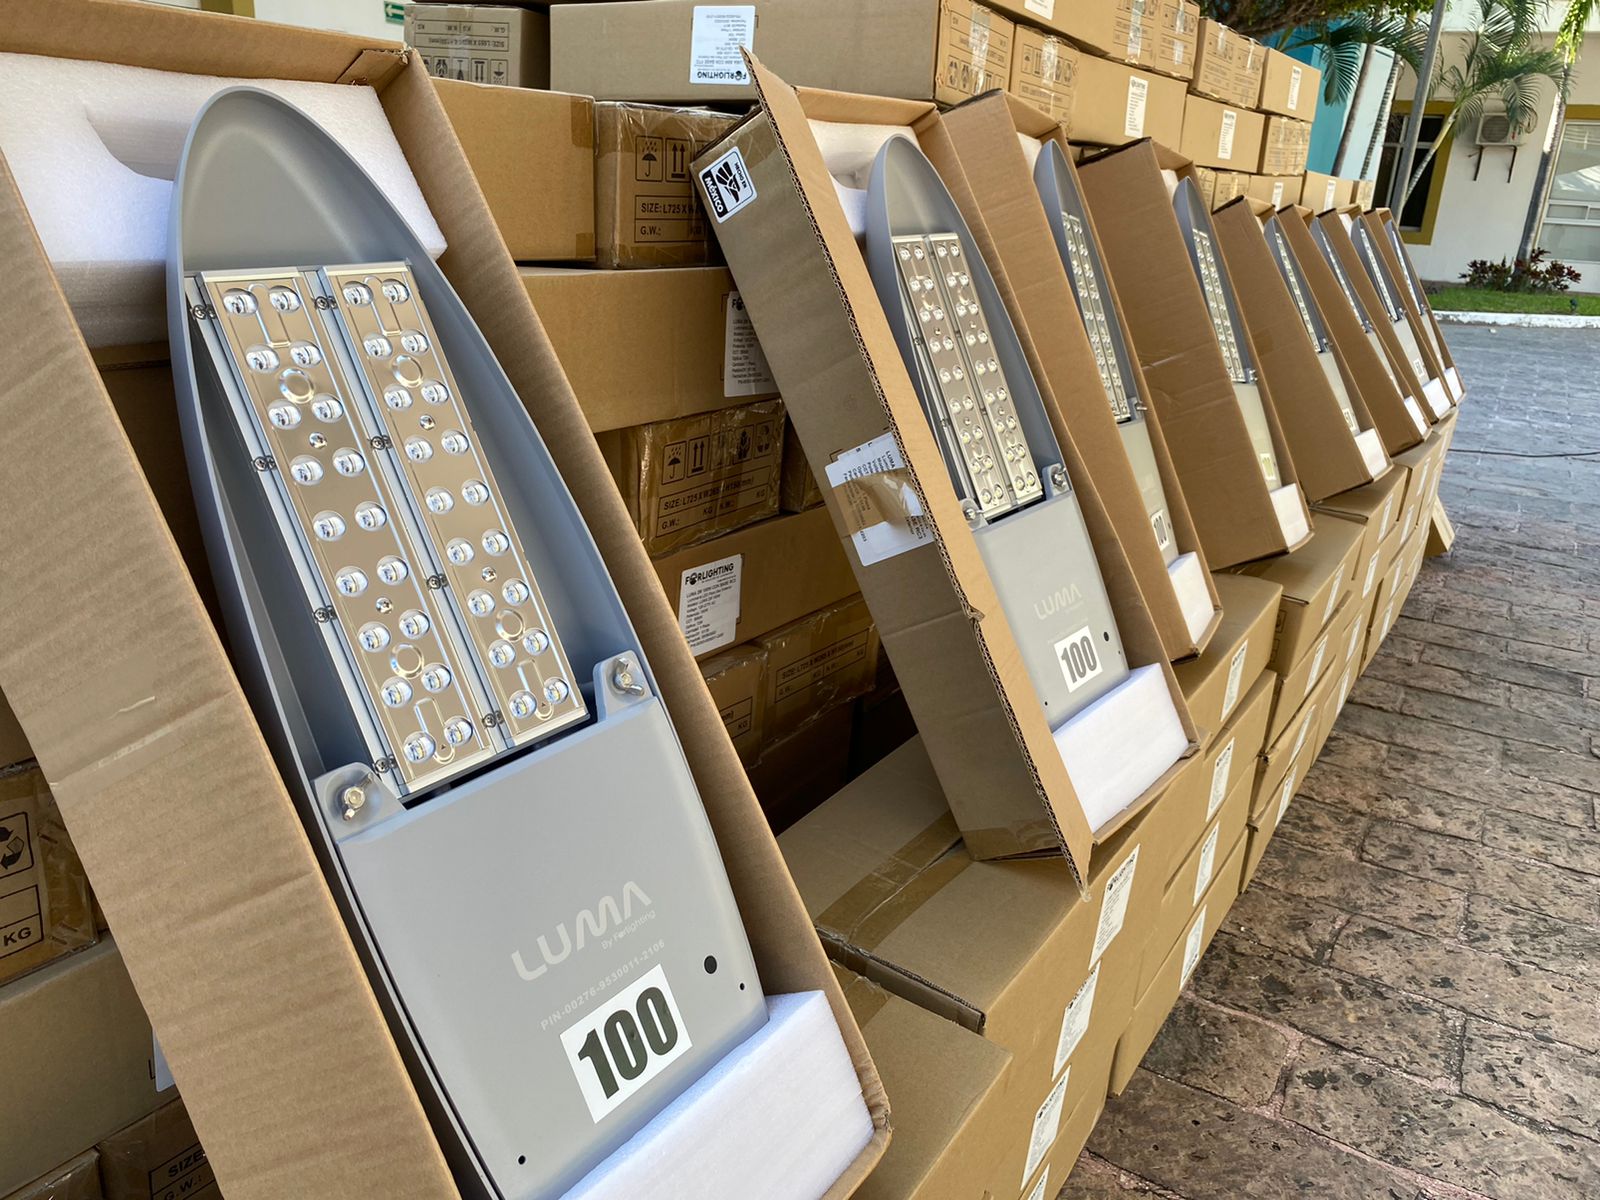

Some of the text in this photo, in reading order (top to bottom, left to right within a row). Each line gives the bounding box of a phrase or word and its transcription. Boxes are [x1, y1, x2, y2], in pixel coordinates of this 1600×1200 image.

[641, 202, 662, 213] SIZE:
[663, 205, 681, 214] L725
[885, 450, 896, 469] LUMA
[684, 562, 734, 586] FORLIGHTING
[1033, 582, 1083, 621] LUMA
[1060, 635, 1098, 684] 100
[3, 926, 33, 947] KG
[511, 881, 653, 982] LUMA
[600, 937, 613, 951] By
[577, 986, 679, 1100] 100
